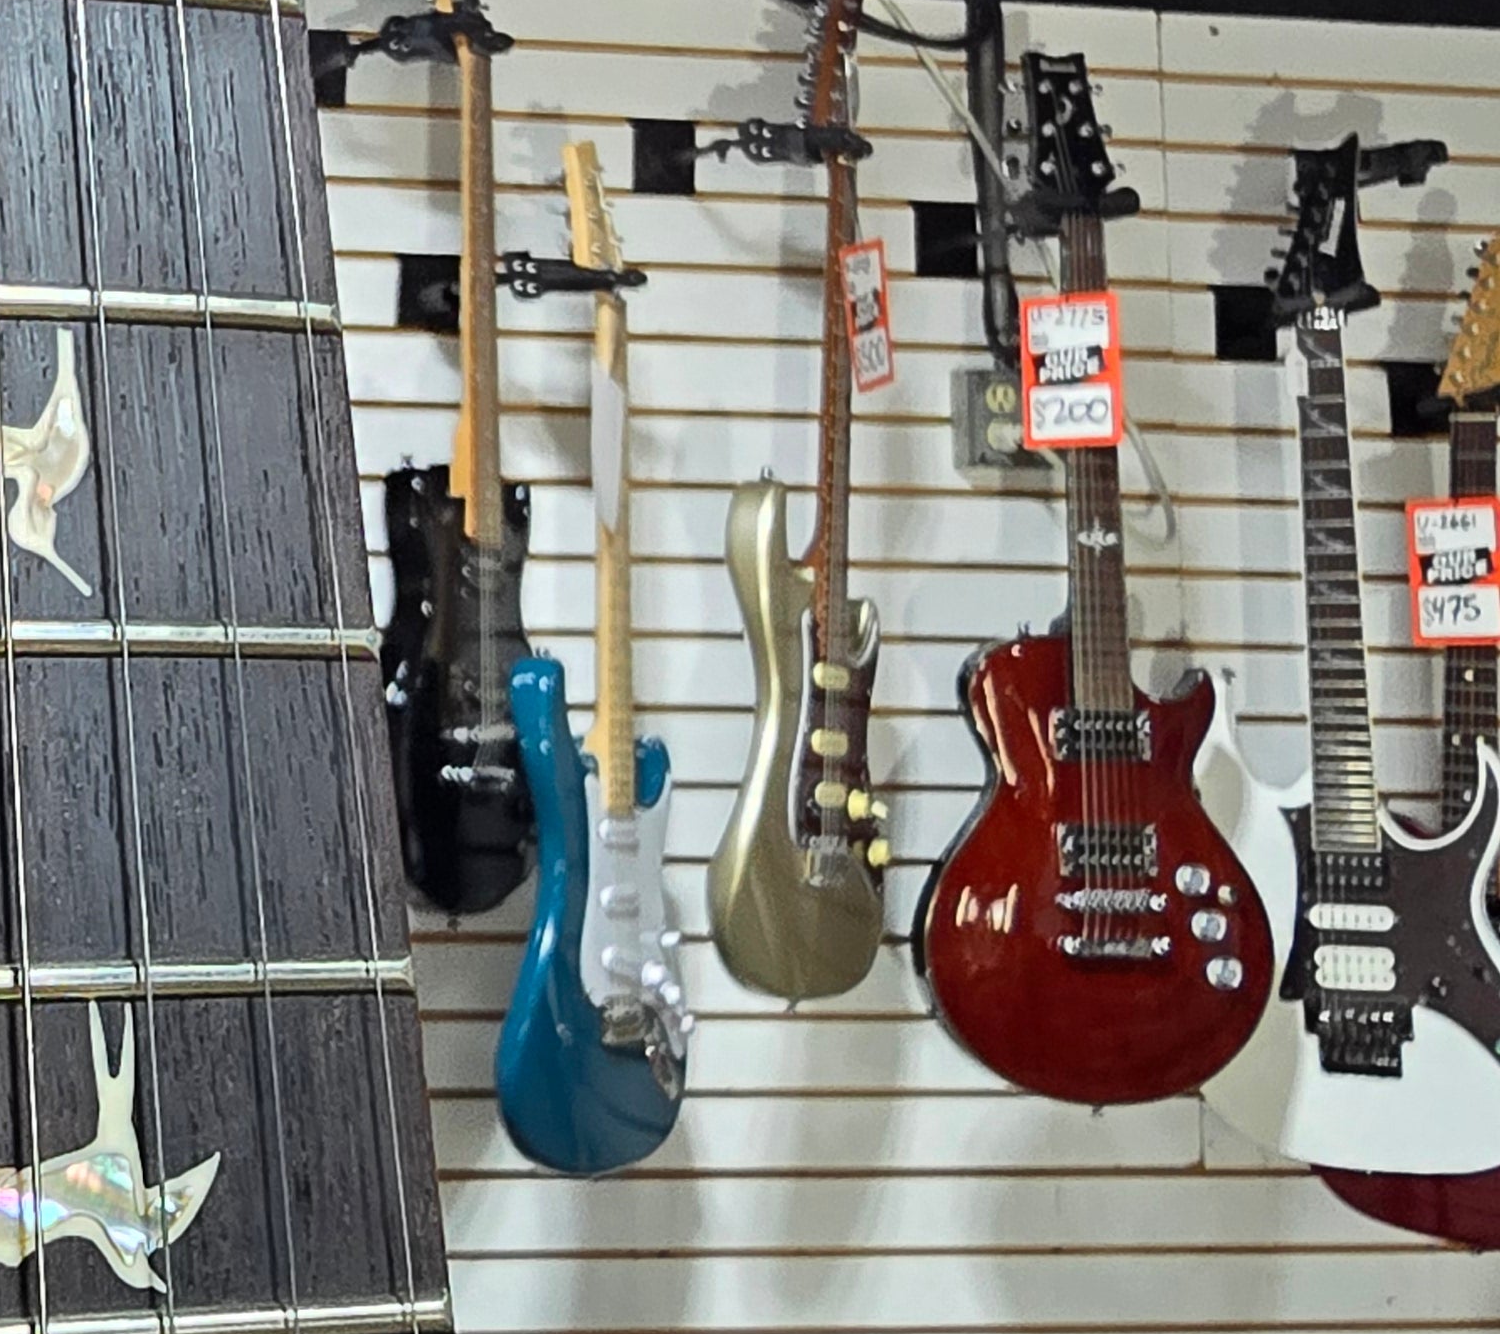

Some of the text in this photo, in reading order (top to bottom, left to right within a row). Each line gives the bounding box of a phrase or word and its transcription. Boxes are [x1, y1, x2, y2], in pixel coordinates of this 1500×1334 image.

[1039, 355, 1100, 384] PRICE
[1045, 346, 1088, 367] OUR
[1033, 396, 1109, 431] $200
[1427, 558, 1488, 586] PRICE
[1432, 549, 1477, 569] OUR
[1423, 592, 1482, 629] $475
